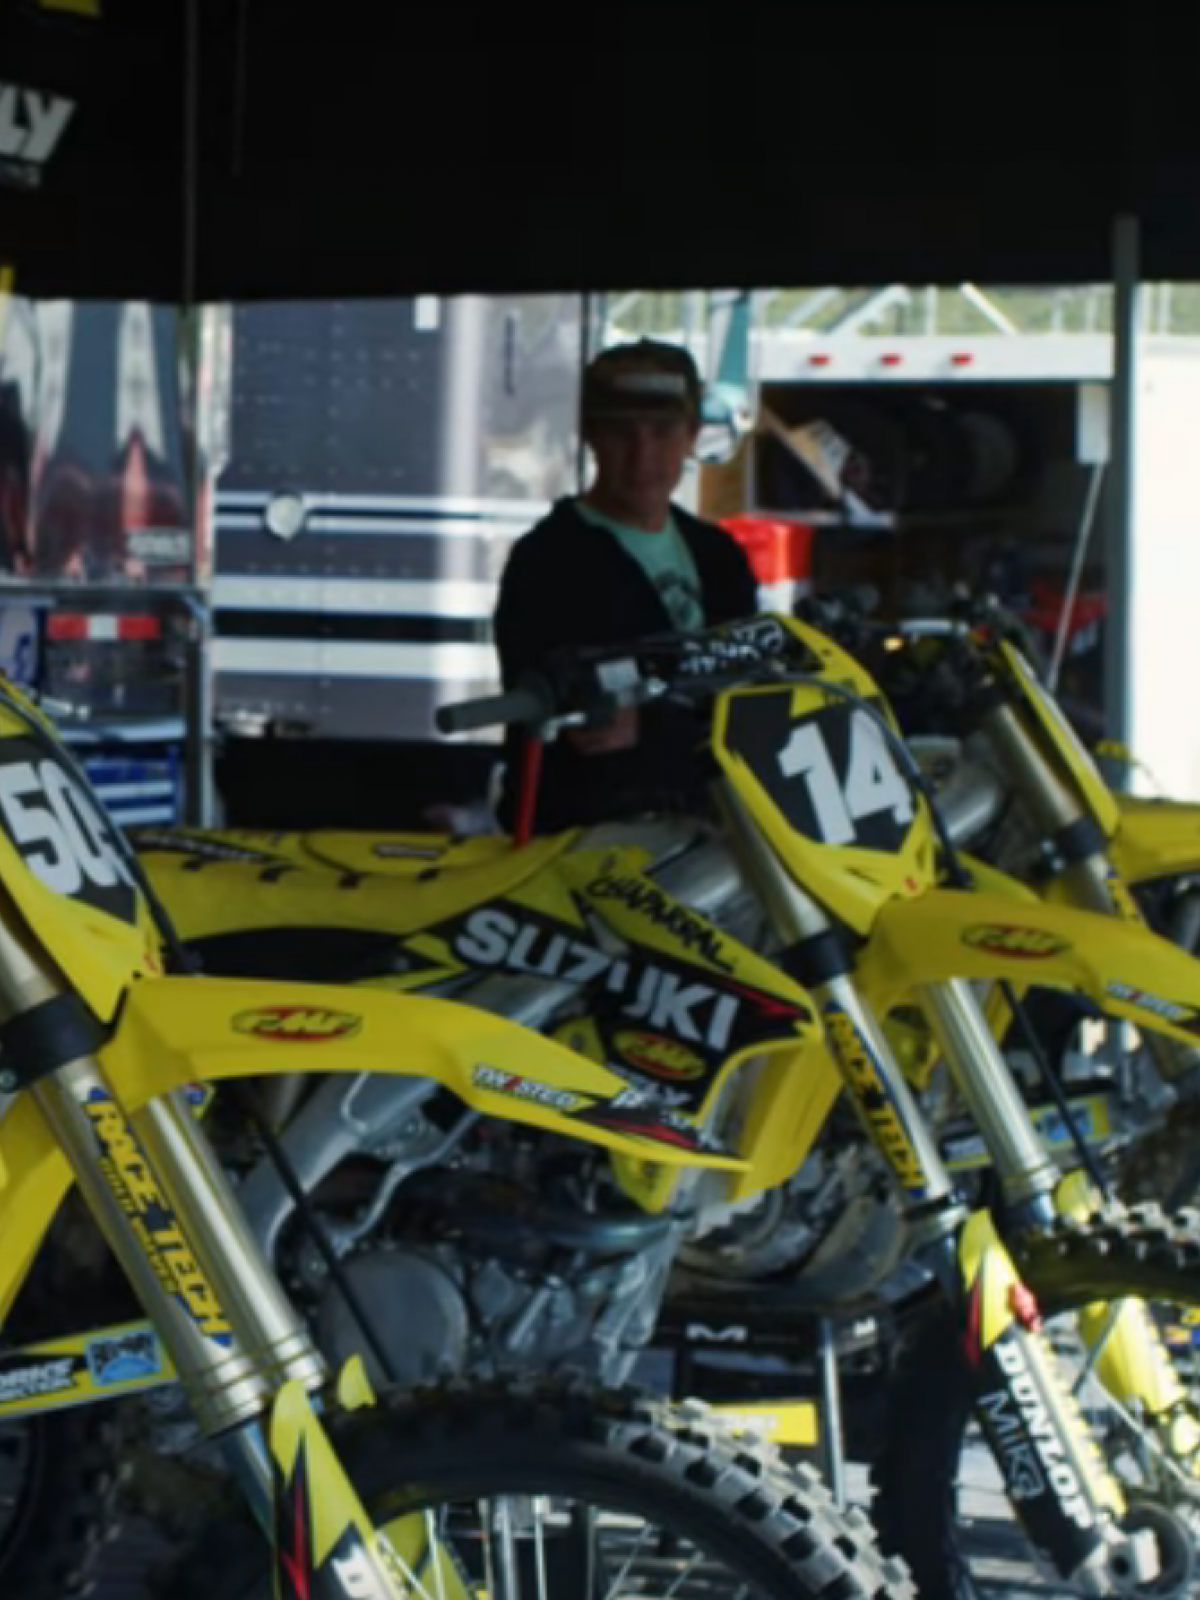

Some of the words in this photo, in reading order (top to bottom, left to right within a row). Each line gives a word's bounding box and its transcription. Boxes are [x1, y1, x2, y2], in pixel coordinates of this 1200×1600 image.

[777, 708, 912, 846] 14
[84, 1102, 170, 1212] RACE
[150, 1226, 234, 1338] TECH
[993, 1338, 1097, 1530] DUNLOP
